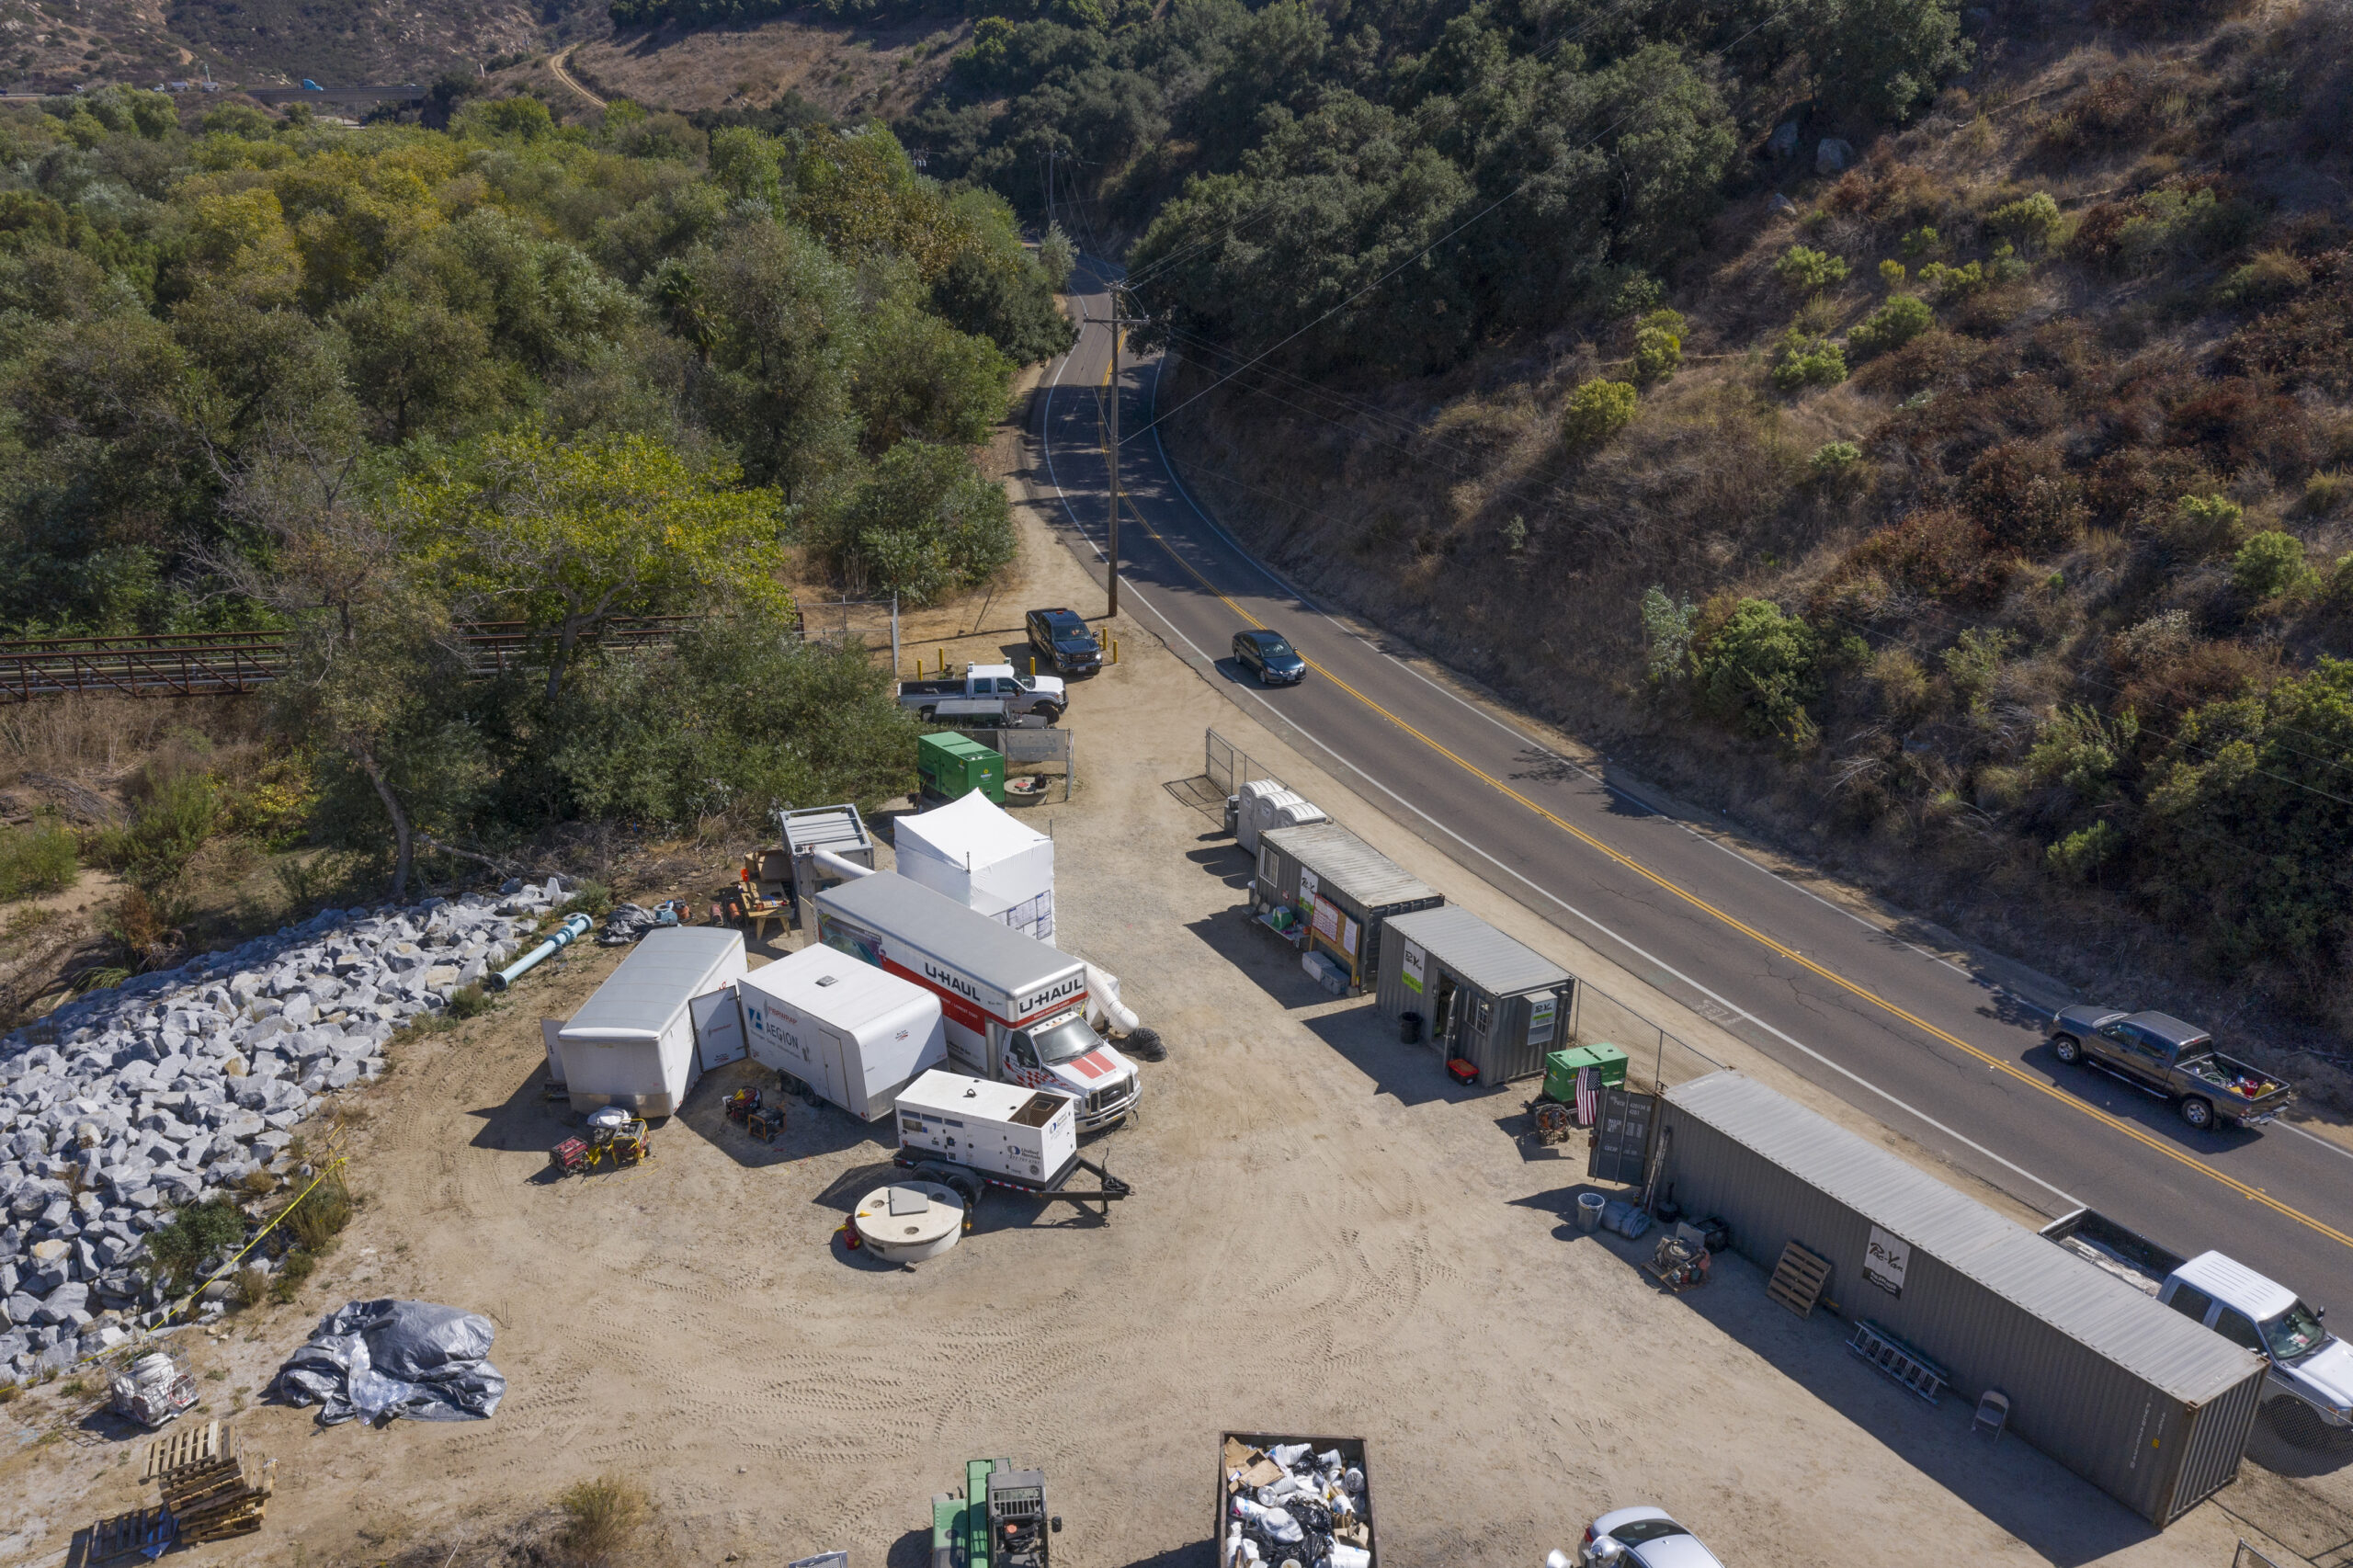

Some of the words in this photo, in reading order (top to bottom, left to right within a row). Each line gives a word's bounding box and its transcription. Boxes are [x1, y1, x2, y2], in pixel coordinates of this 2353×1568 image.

[925, 962, 981, 1002] U-HAUL
[1019, 978, 1083, 1014] U-HAUL
[766, 1021, 799, 1049] AEGION
[1869, 1242, 1904, 1273] Pac-Van
